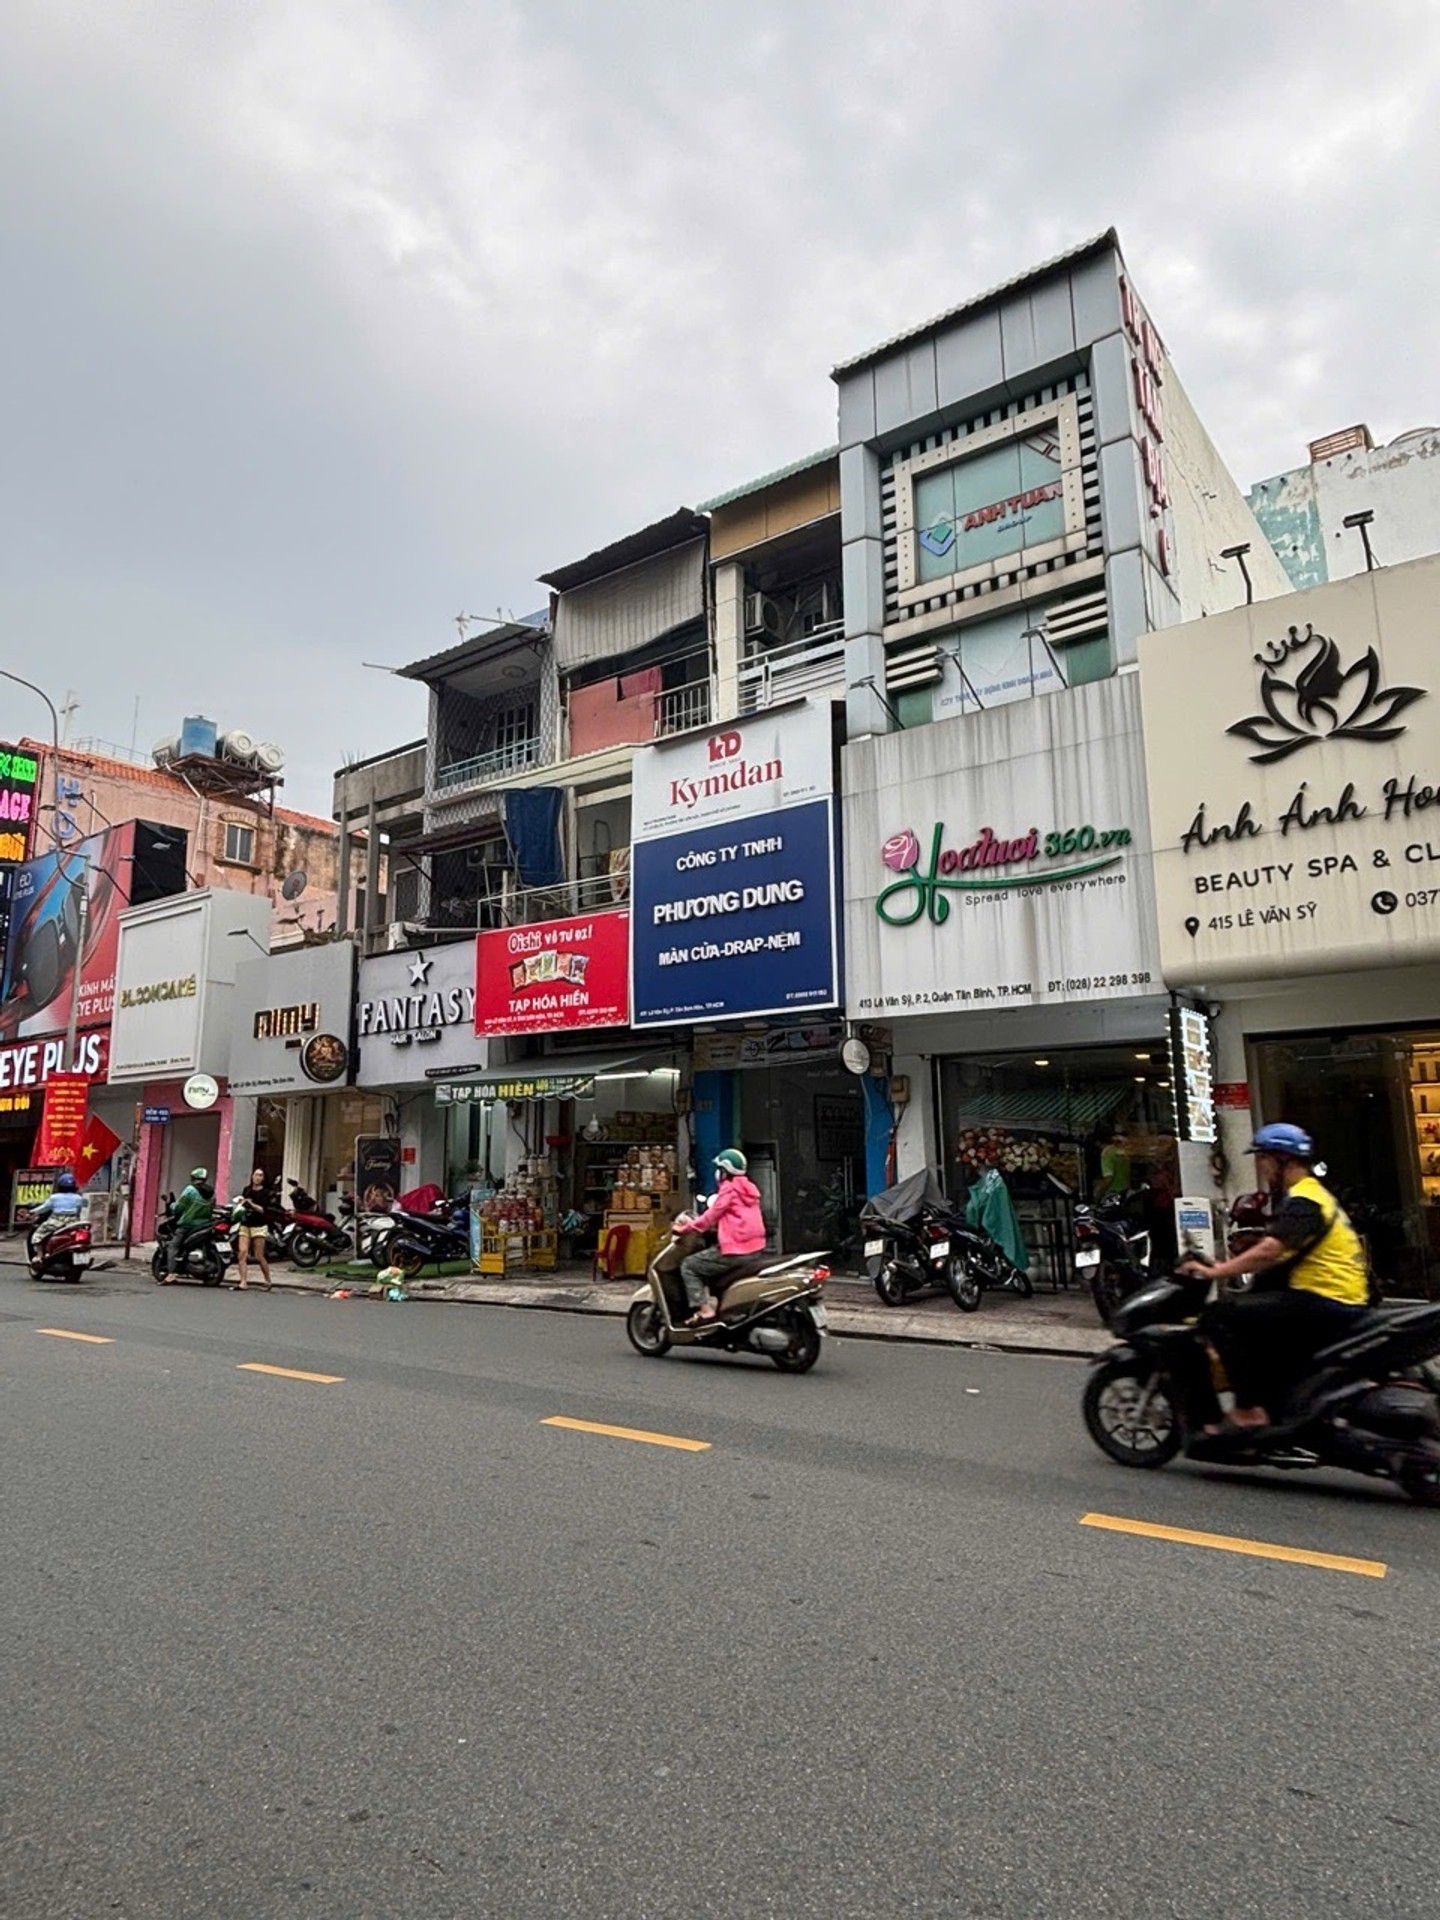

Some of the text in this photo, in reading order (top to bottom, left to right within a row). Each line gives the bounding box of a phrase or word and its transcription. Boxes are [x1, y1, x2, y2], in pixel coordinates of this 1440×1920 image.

[964, 501, 1006, 533] ANH
[669, 759, 785, 808] Kymdan
[1180, 774, 1440, 855] Ánh Ánh Ho
[676, 836, 783, 872] CÔNG TY TNHH
[1194, 862, 1294, 894] BEAUTY
[1307, 854, 1358, 878] SPA
[1373, 849, 1391, 868] &
[653, 879, 804, 925] PHƯƠNG DUNG
[965, 873, 1127, 907] Spread love everywhere
[1405, 888, 1440, 908] 037
[1208, 901, 1318, 931] 415 LÊ VĂN SỸ
[508, 930, 542, 954] Oishi
[658, 946, 689, 967] MÀN
[1093, 975, 1107, 989] 22
[1108, 974, 1128, 987] 298
[359, 986, 476, 1035] FANTASY
[532, 993, 558, 1011] HÓA
[0, 1044, 39, 1089] EYE
